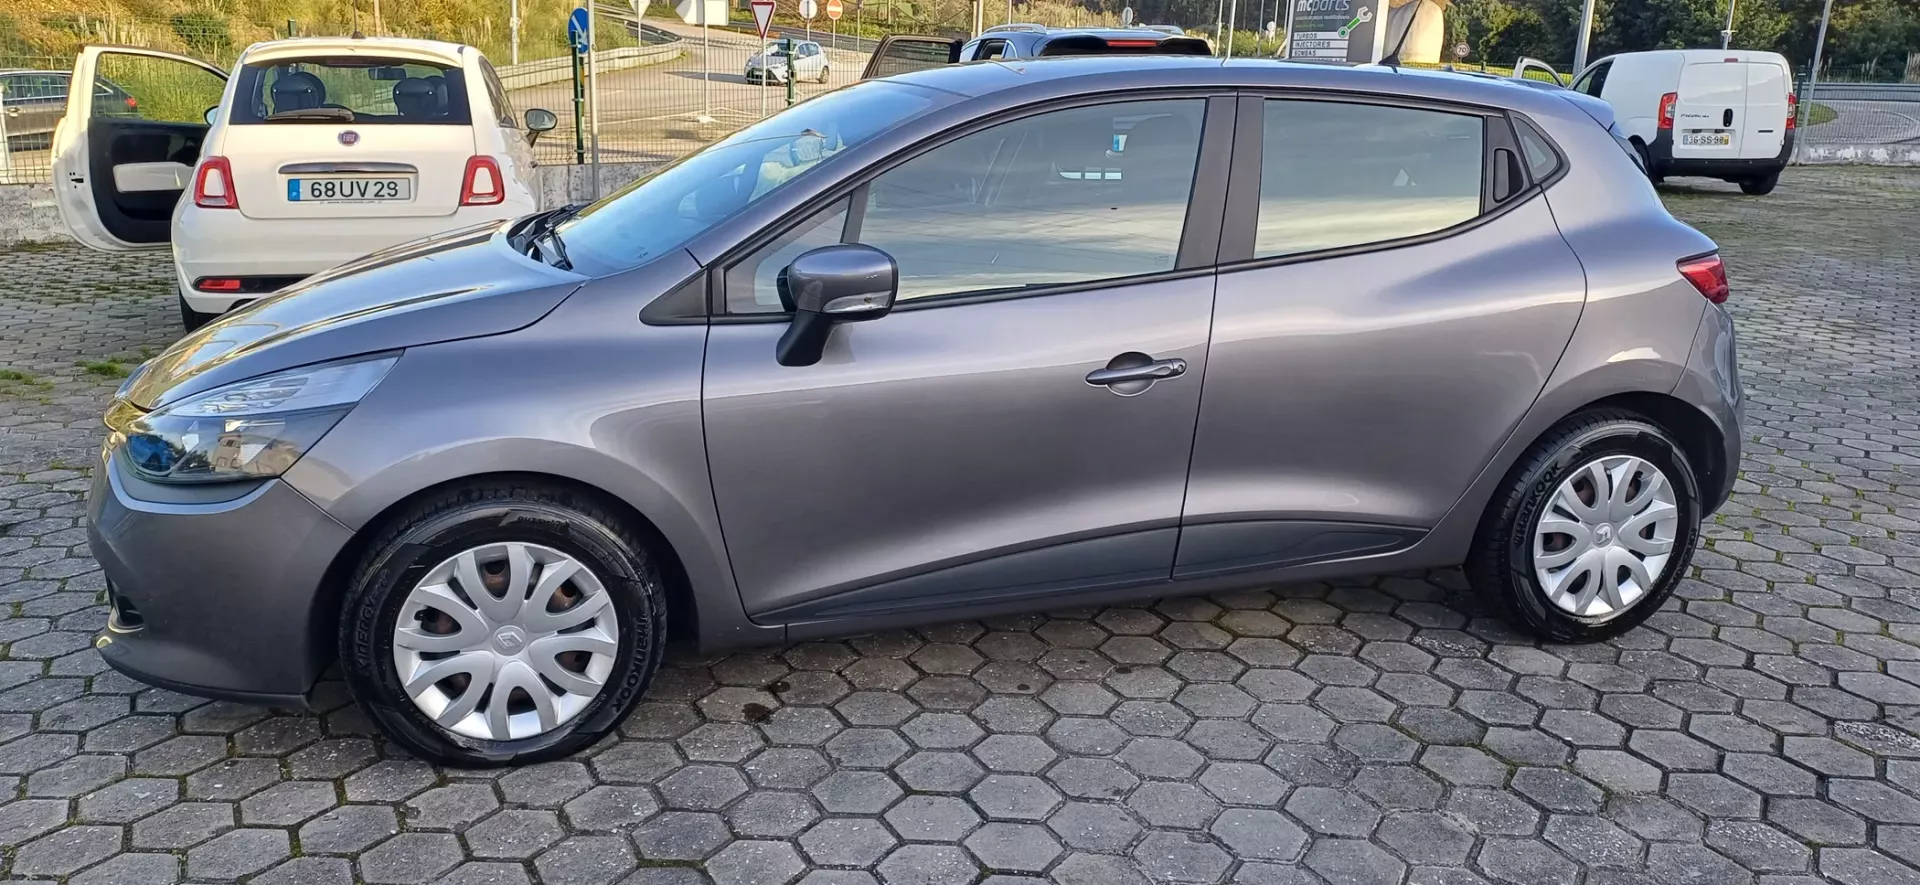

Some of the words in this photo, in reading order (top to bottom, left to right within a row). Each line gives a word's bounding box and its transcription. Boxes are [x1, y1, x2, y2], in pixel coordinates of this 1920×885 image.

[1296, 0, 1350, 15] mcparts
[311, 181, 336, 198] 68
[340, 181, 369, 198] UV
[373, 181, 398, 198] 29
